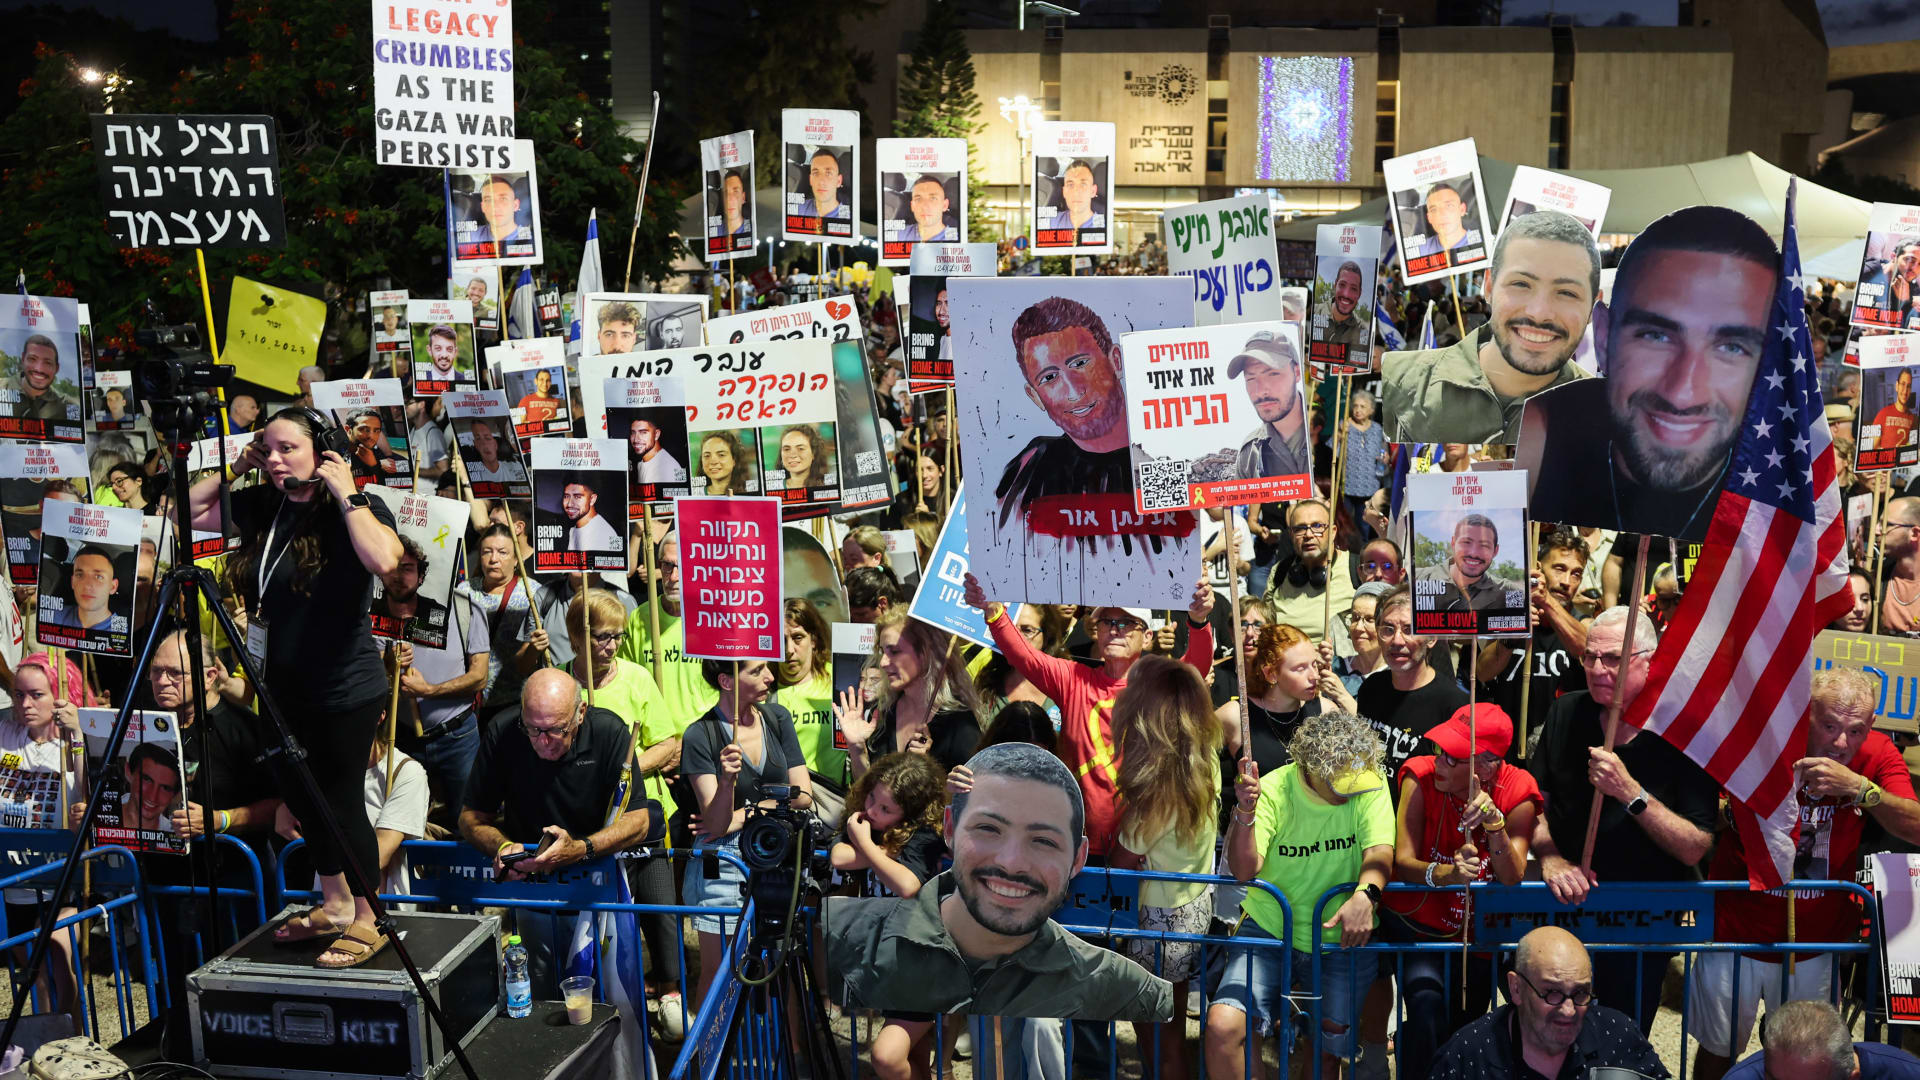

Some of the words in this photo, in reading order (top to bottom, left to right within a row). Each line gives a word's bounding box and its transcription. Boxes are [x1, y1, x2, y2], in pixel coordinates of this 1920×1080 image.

[388, 6, 499, 38] LEGACY
[375, 39, 513, 72] CRUMBLES
[395, 74, 430, 99] AS
[441, 77, 494, 103] THE
[376, 108, 447, 133] GAZA
[456, 113, 514, 137] WAR
[1141, 125, 1194, 136] ספריית
[105, 124, 164, 157] את
[178, 119, 270, 157] תציל
[382, 139, 511, 170] PERSISTS
[1167, 150, 1193, 160] בית
[112, 165, 275, 199] המדינה
[787, 192, 806, 205] BRING
[109, 208, 271, 249] מעצמך
[1037, 230, 1056, 242] HOME
[885, 242, 905, 254] HOME
[1407, 257, 1429, 271] HOME
[1860, 282, 1885, 296] BRING
[1857, 294, 1874, 307] HIM
[769, 315, 790, 329] הימן
[794, 311, 813, 327] ענבר
[1855, 306, 1879, 320] HOME
[1879, 309, 1903, 322] NOW!
[750, 318, 769, 336] (27)
[911, 333, 935, 346] BRING
[911, 346, 926, 359] HIM
[1147, 341, 1210, 363] מחזירים
[693, 351, 766, 373] ענבר
[911, 361, 933, 374] HOME
[1146, 369, 1184, 390] איתי
[1190, 366, 1215, 387] את
[718, 371, 829, 399] הופקרה
[716, 397, 797, 422] האשה
[1142, 393, 1229, 430] הביתה
[1861, 424, 1882, 437] BRING
[1860, 438, 1874, 451] HIM
[1455, 477, 1463, 485] חן
[1464, 476, 1479, 485] איתי
[1452, 486, 1465, 495] ITAY
[1466, 486, 1483, 495] CHEN
[399, 505, 414, 518] ALON
[414, 508, 428, 518] OHEL
[1060, 508, 1099, 526] אור
[84, 517, 110, 528] ANGREST
[537, 525, 563, 538] BRING
[700, 520, 760, 543] תקווה
[7, 537, 31, 550] BRING
[203, 537, 224, 552] NOW!
[538, 538, 555, 551] HIM
[9, 551, 25, 563] HIM
[537, 552, 562, 565] HOME
[563, 551, 587, 565] NOW!
[689, 543, 766, 561] ונחישות
[691, 566, 765, 584] ציבורית
[1415, 579, 1446, 595] BRING
[39, 594, 64, 611] BRING
[700, 588, 764, 606] משנים
[1416, 596, 1436, 611] HIM
[39, 608, 54, 623] HIM
[696, 611, 769, 629] מציאות
[1416, 613, 1446, 628] HOME
[1447, 611, 1477, 627] NOW!
[97, 642, 107, 651] לא
[1833, 636, 1905, 666] כולם
[125, 830, 136, 839] את
[156, 832, 165, 841] לא
[1325, 833, 1357, 850] אנחנו
[1278, 841, 1321, 858] אתכם
[1890, 978, 1912, 995] HIM
[1892, 997, 1920, 1013] HOM
[203, 1011, 273, 1038] VOICE
